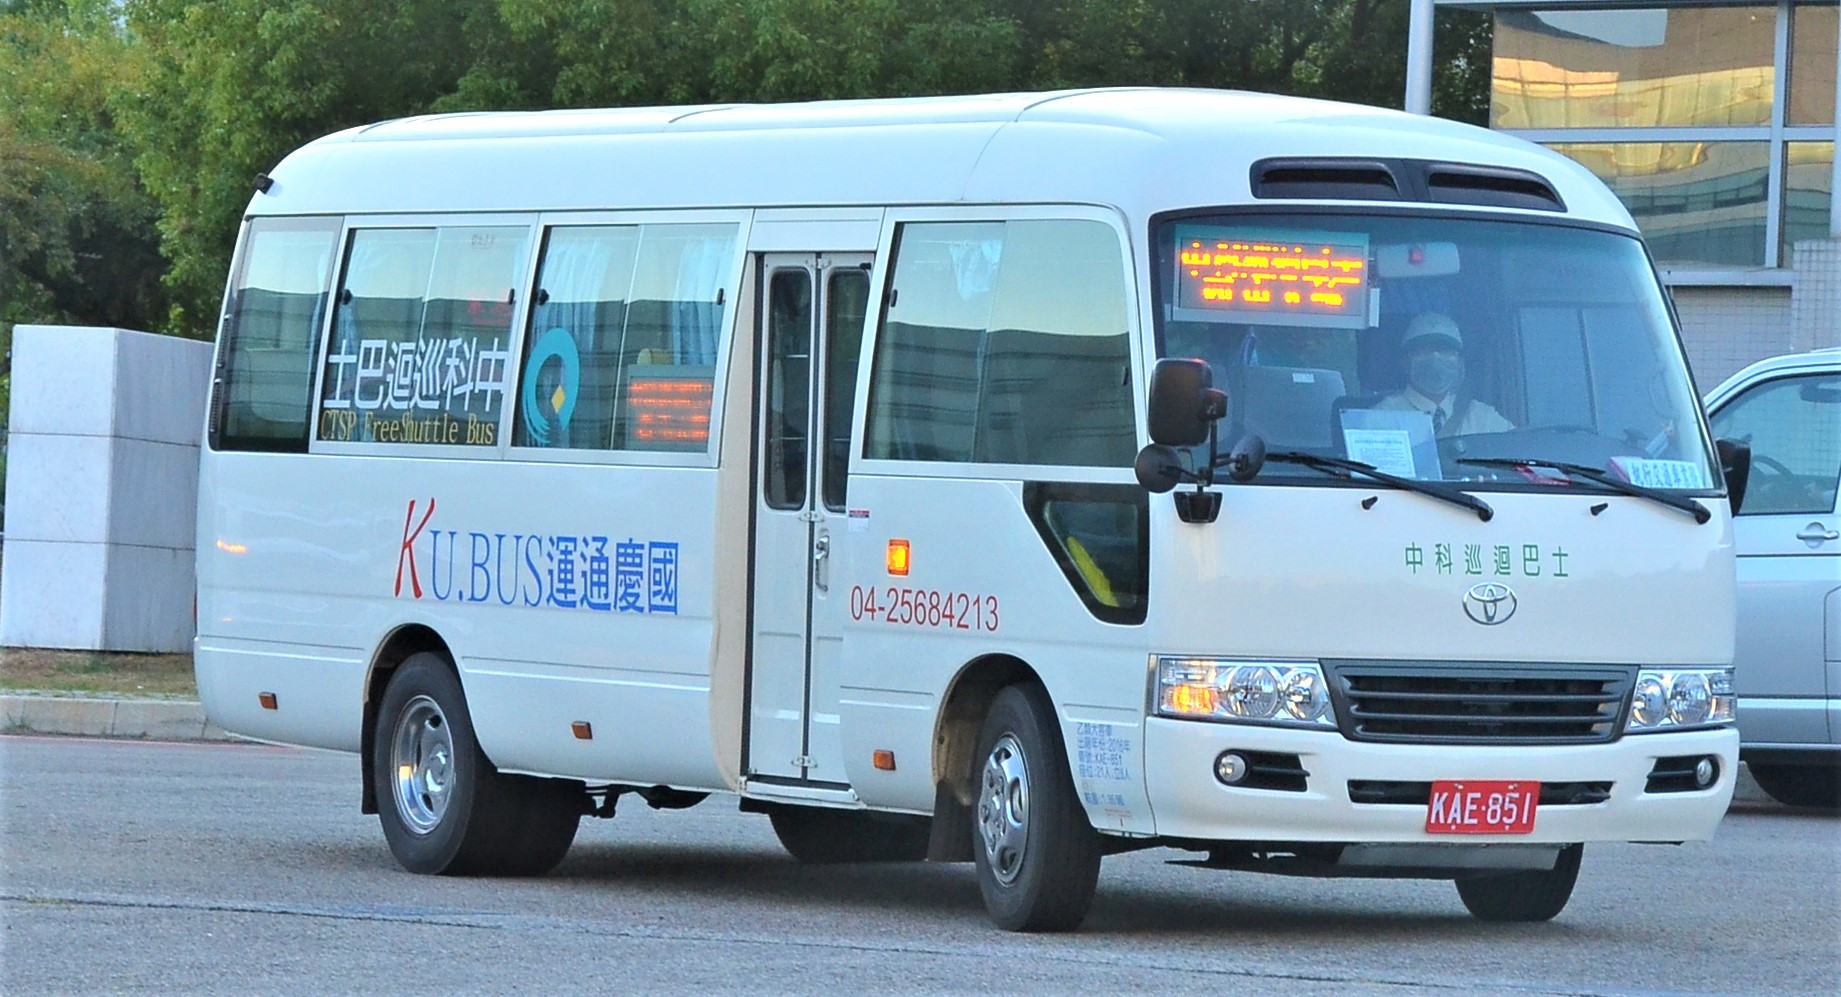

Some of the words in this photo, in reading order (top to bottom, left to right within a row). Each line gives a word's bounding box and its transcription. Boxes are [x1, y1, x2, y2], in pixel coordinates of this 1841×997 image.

[321, 410, 357, 440] CTSP
[466, 413, 495, 444] Bus
[851, 585, 999, 632] 04-25684213
